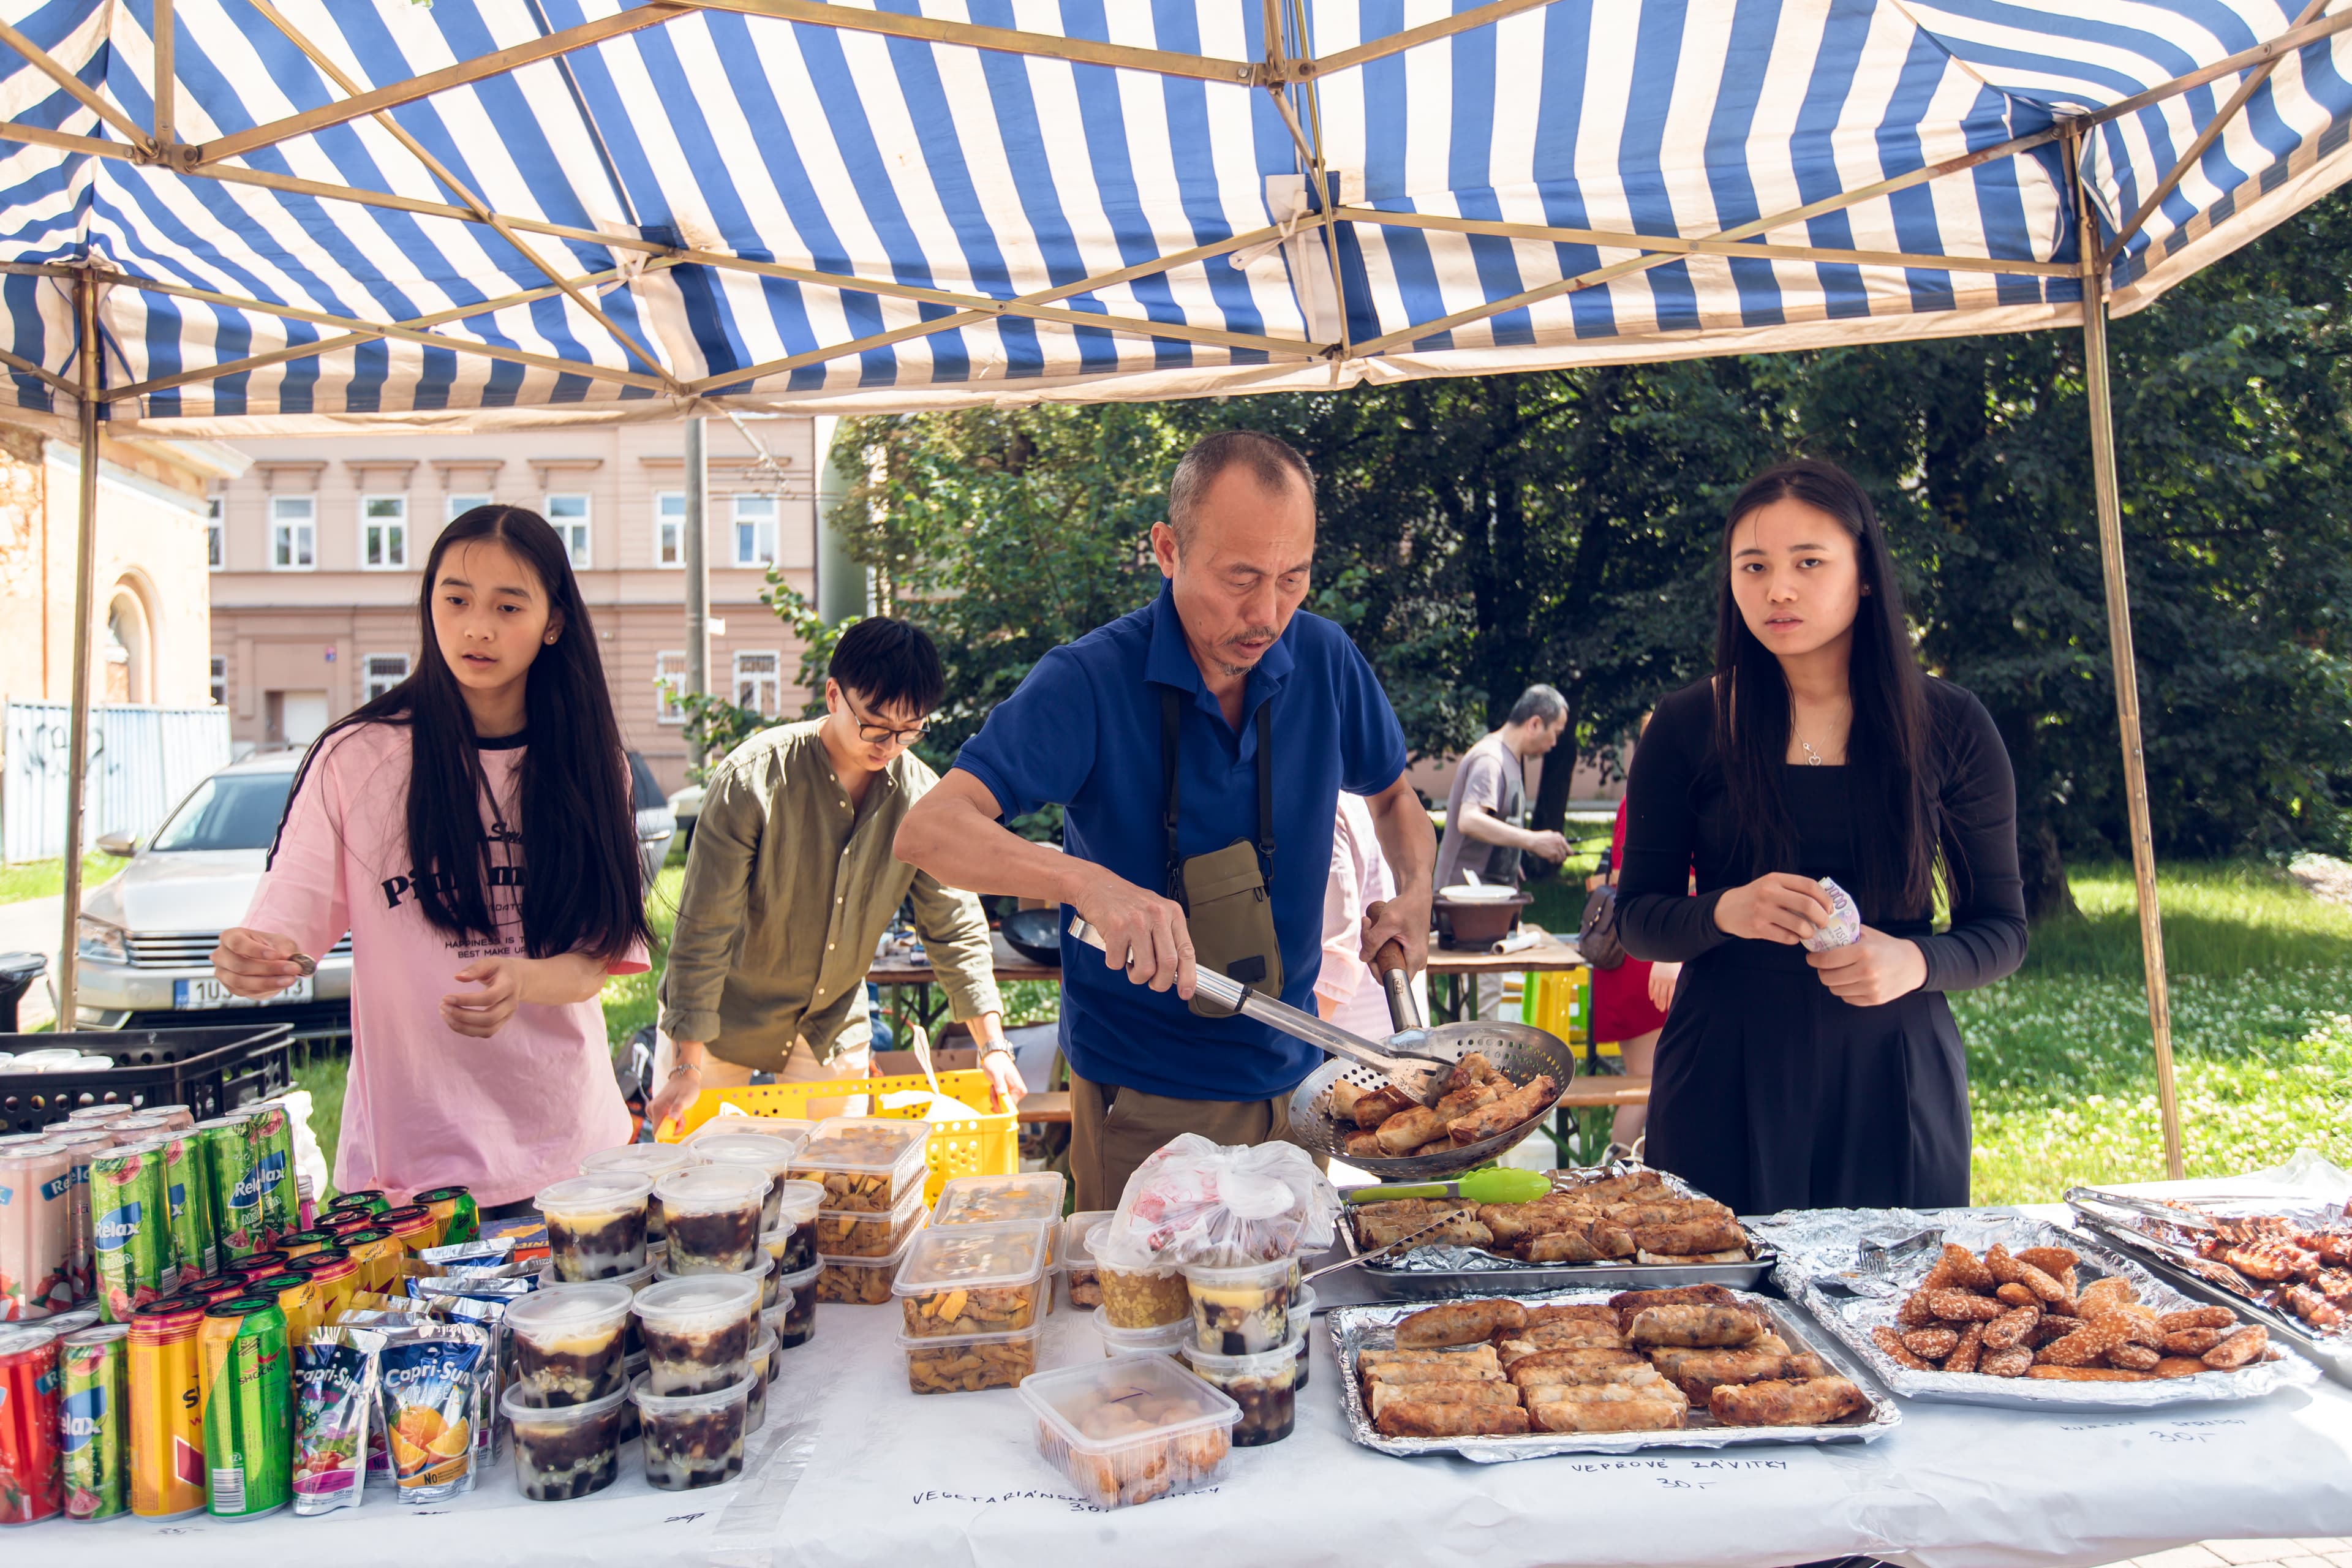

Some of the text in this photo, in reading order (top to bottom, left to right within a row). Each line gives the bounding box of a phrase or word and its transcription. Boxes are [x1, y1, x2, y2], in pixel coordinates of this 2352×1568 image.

[1824, 882, 1847, 910] 1000
[445, 937, 500, 948] HAPPINESS
[458, 950, 480, 959] BEST
[484, 947, 510, 956] MAKE
[95, 1222, 140, 1238] Relax
[295, 1364, 360, 1398] Capri-Sun
[385, 1359, 470, 1388] Capri-Sun
[405, 1385, 449, 1401] ORANGE
[61, 1412, 102, 1436] elax
[1570, 1458, 1787, 1472] VEPŘOVÉ ZÁVITKY
[424, 1472, 438, 1485] No
